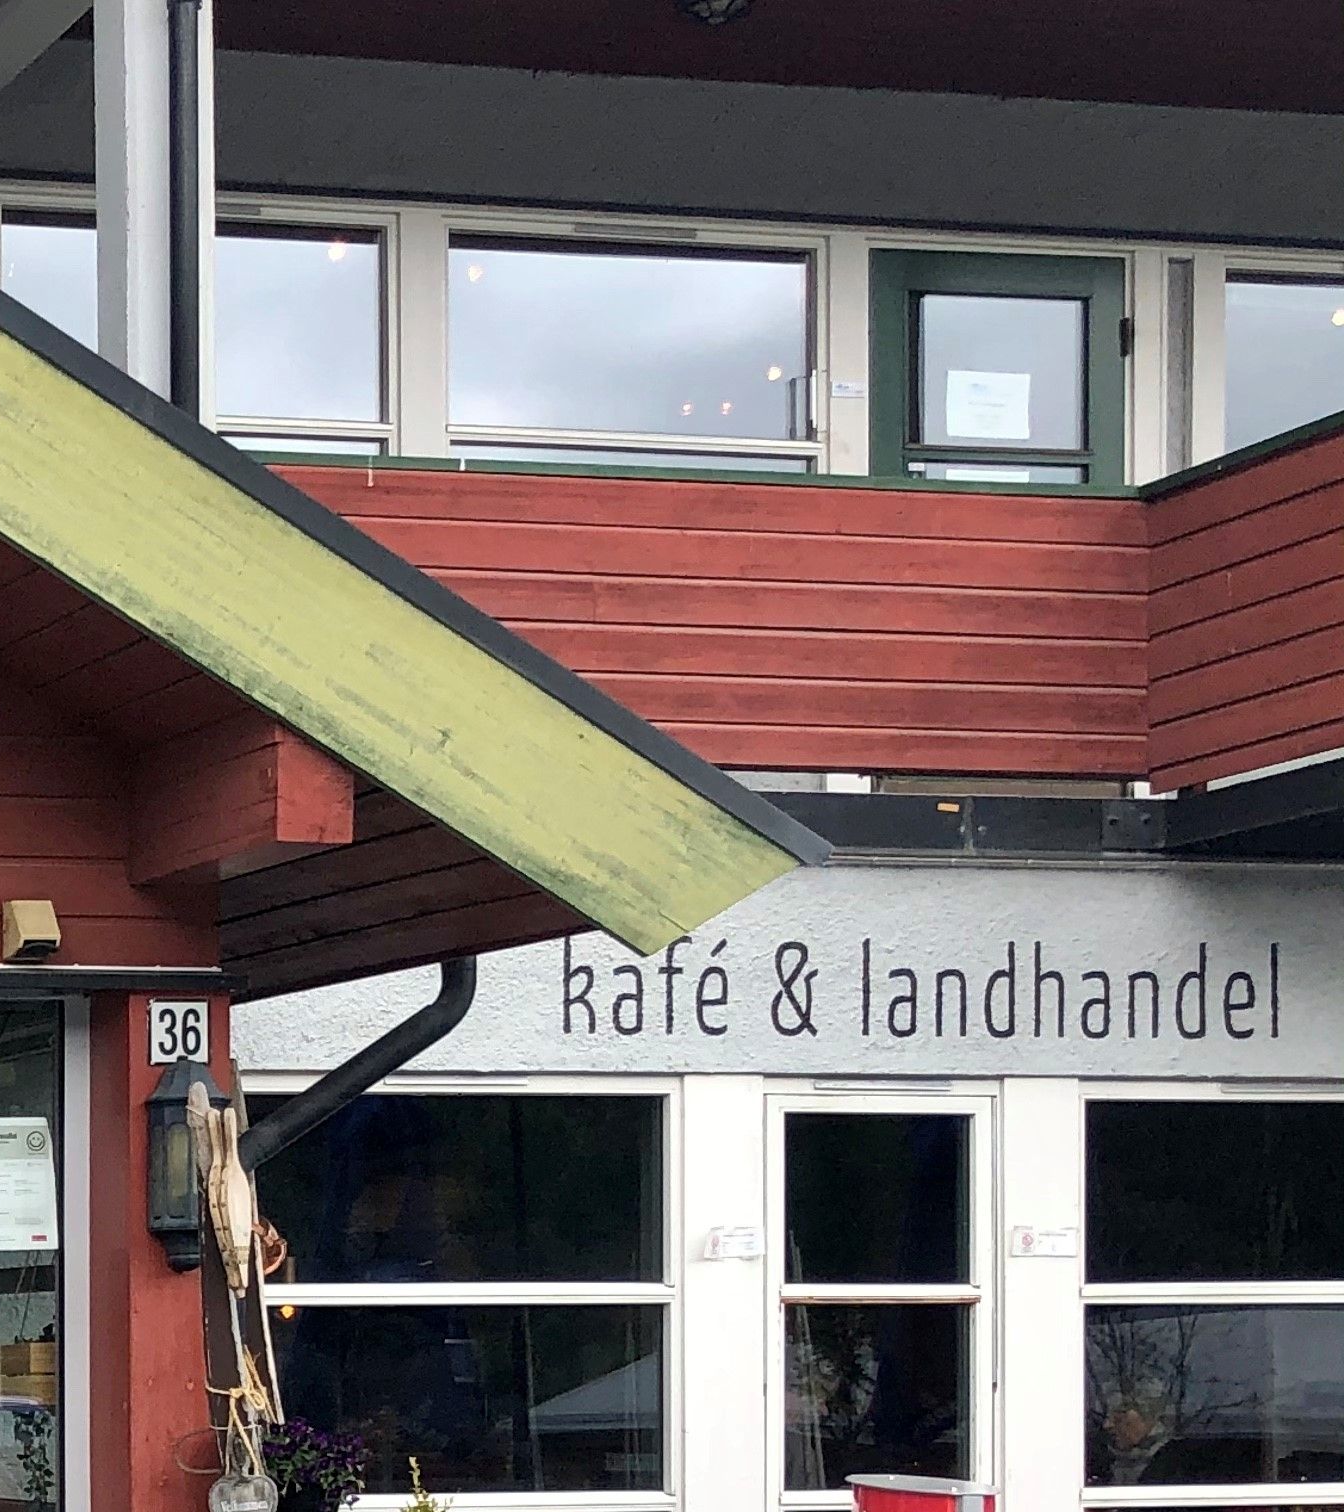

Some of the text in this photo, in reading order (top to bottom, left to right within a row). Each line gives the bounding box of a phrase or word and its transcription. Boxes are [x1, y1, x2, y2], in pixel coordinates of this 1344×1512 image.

[562, 935, 1280, 1039] kafé & landhandel
[157, 1008, 202, 1056] 36
